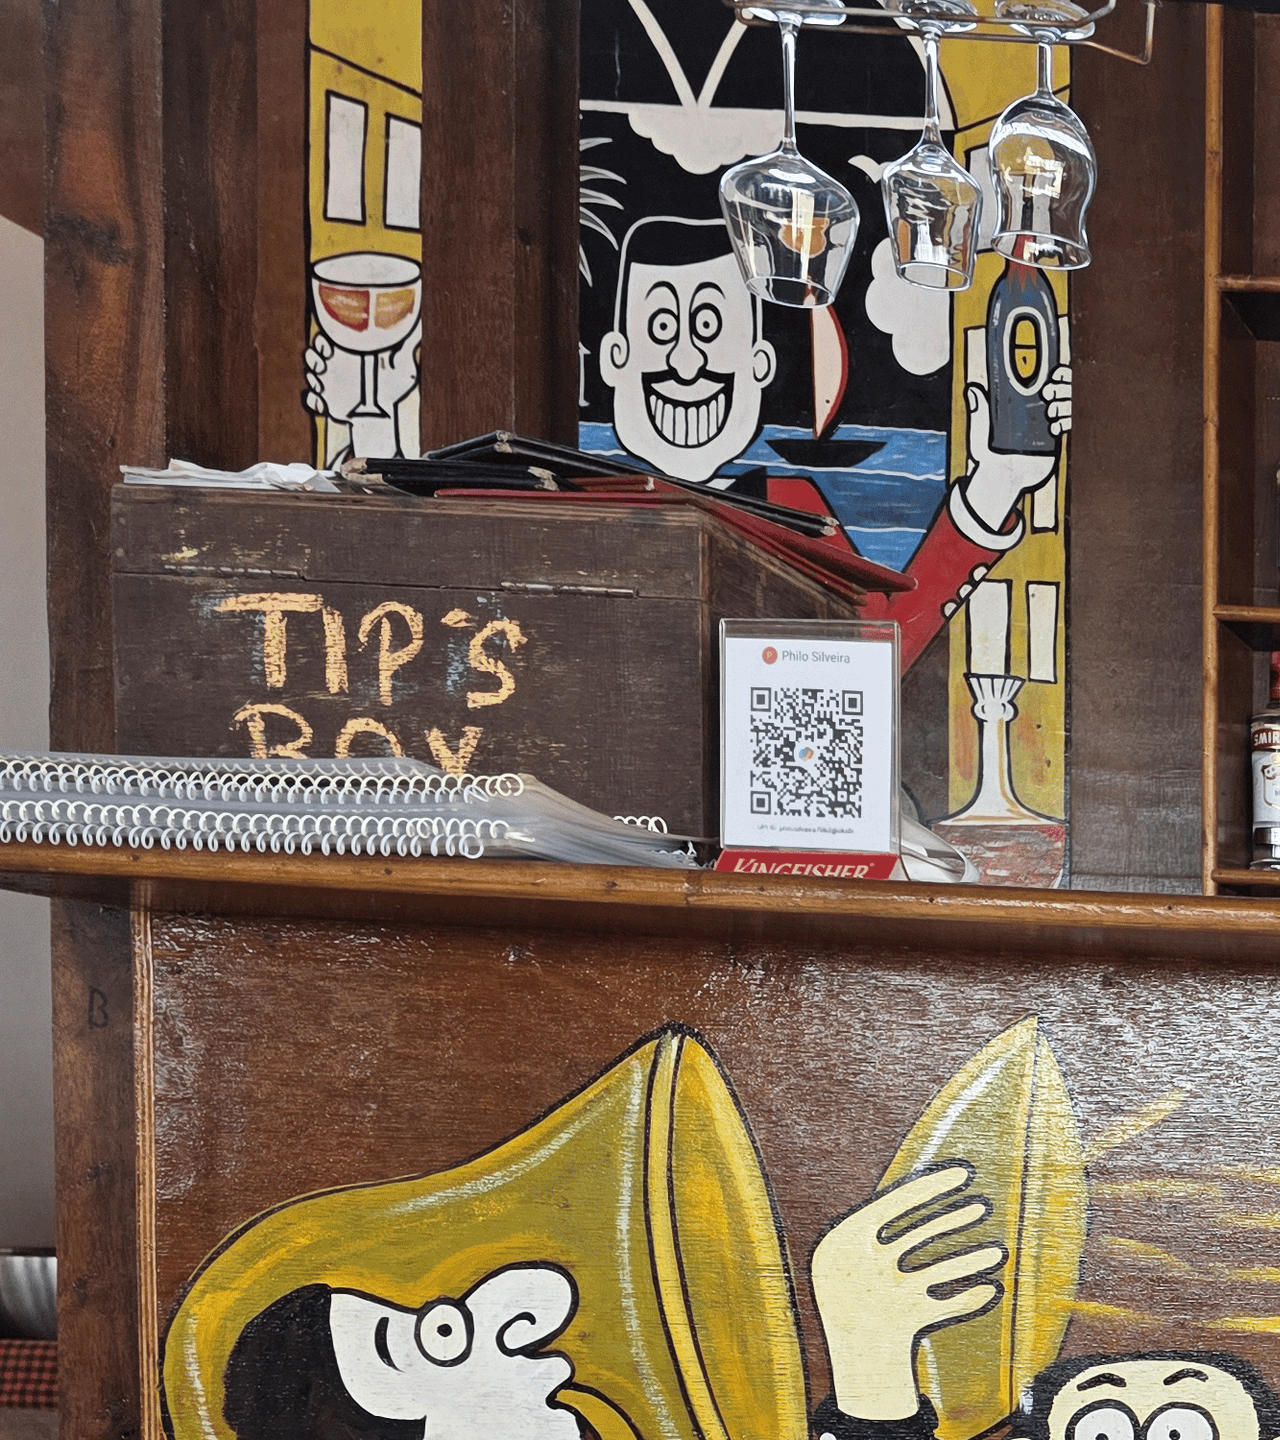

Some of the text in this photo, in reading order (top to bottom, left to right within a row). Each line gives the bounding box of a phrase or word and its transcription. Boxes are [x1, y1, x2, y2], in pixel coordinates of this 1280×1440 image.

[214, 592, 528, 708] TIP'S
[782, 650, 809, 662] Philo
[811, 651, 851, 664] Silveira
[733, 858, 869, 878] KINGFISHER
